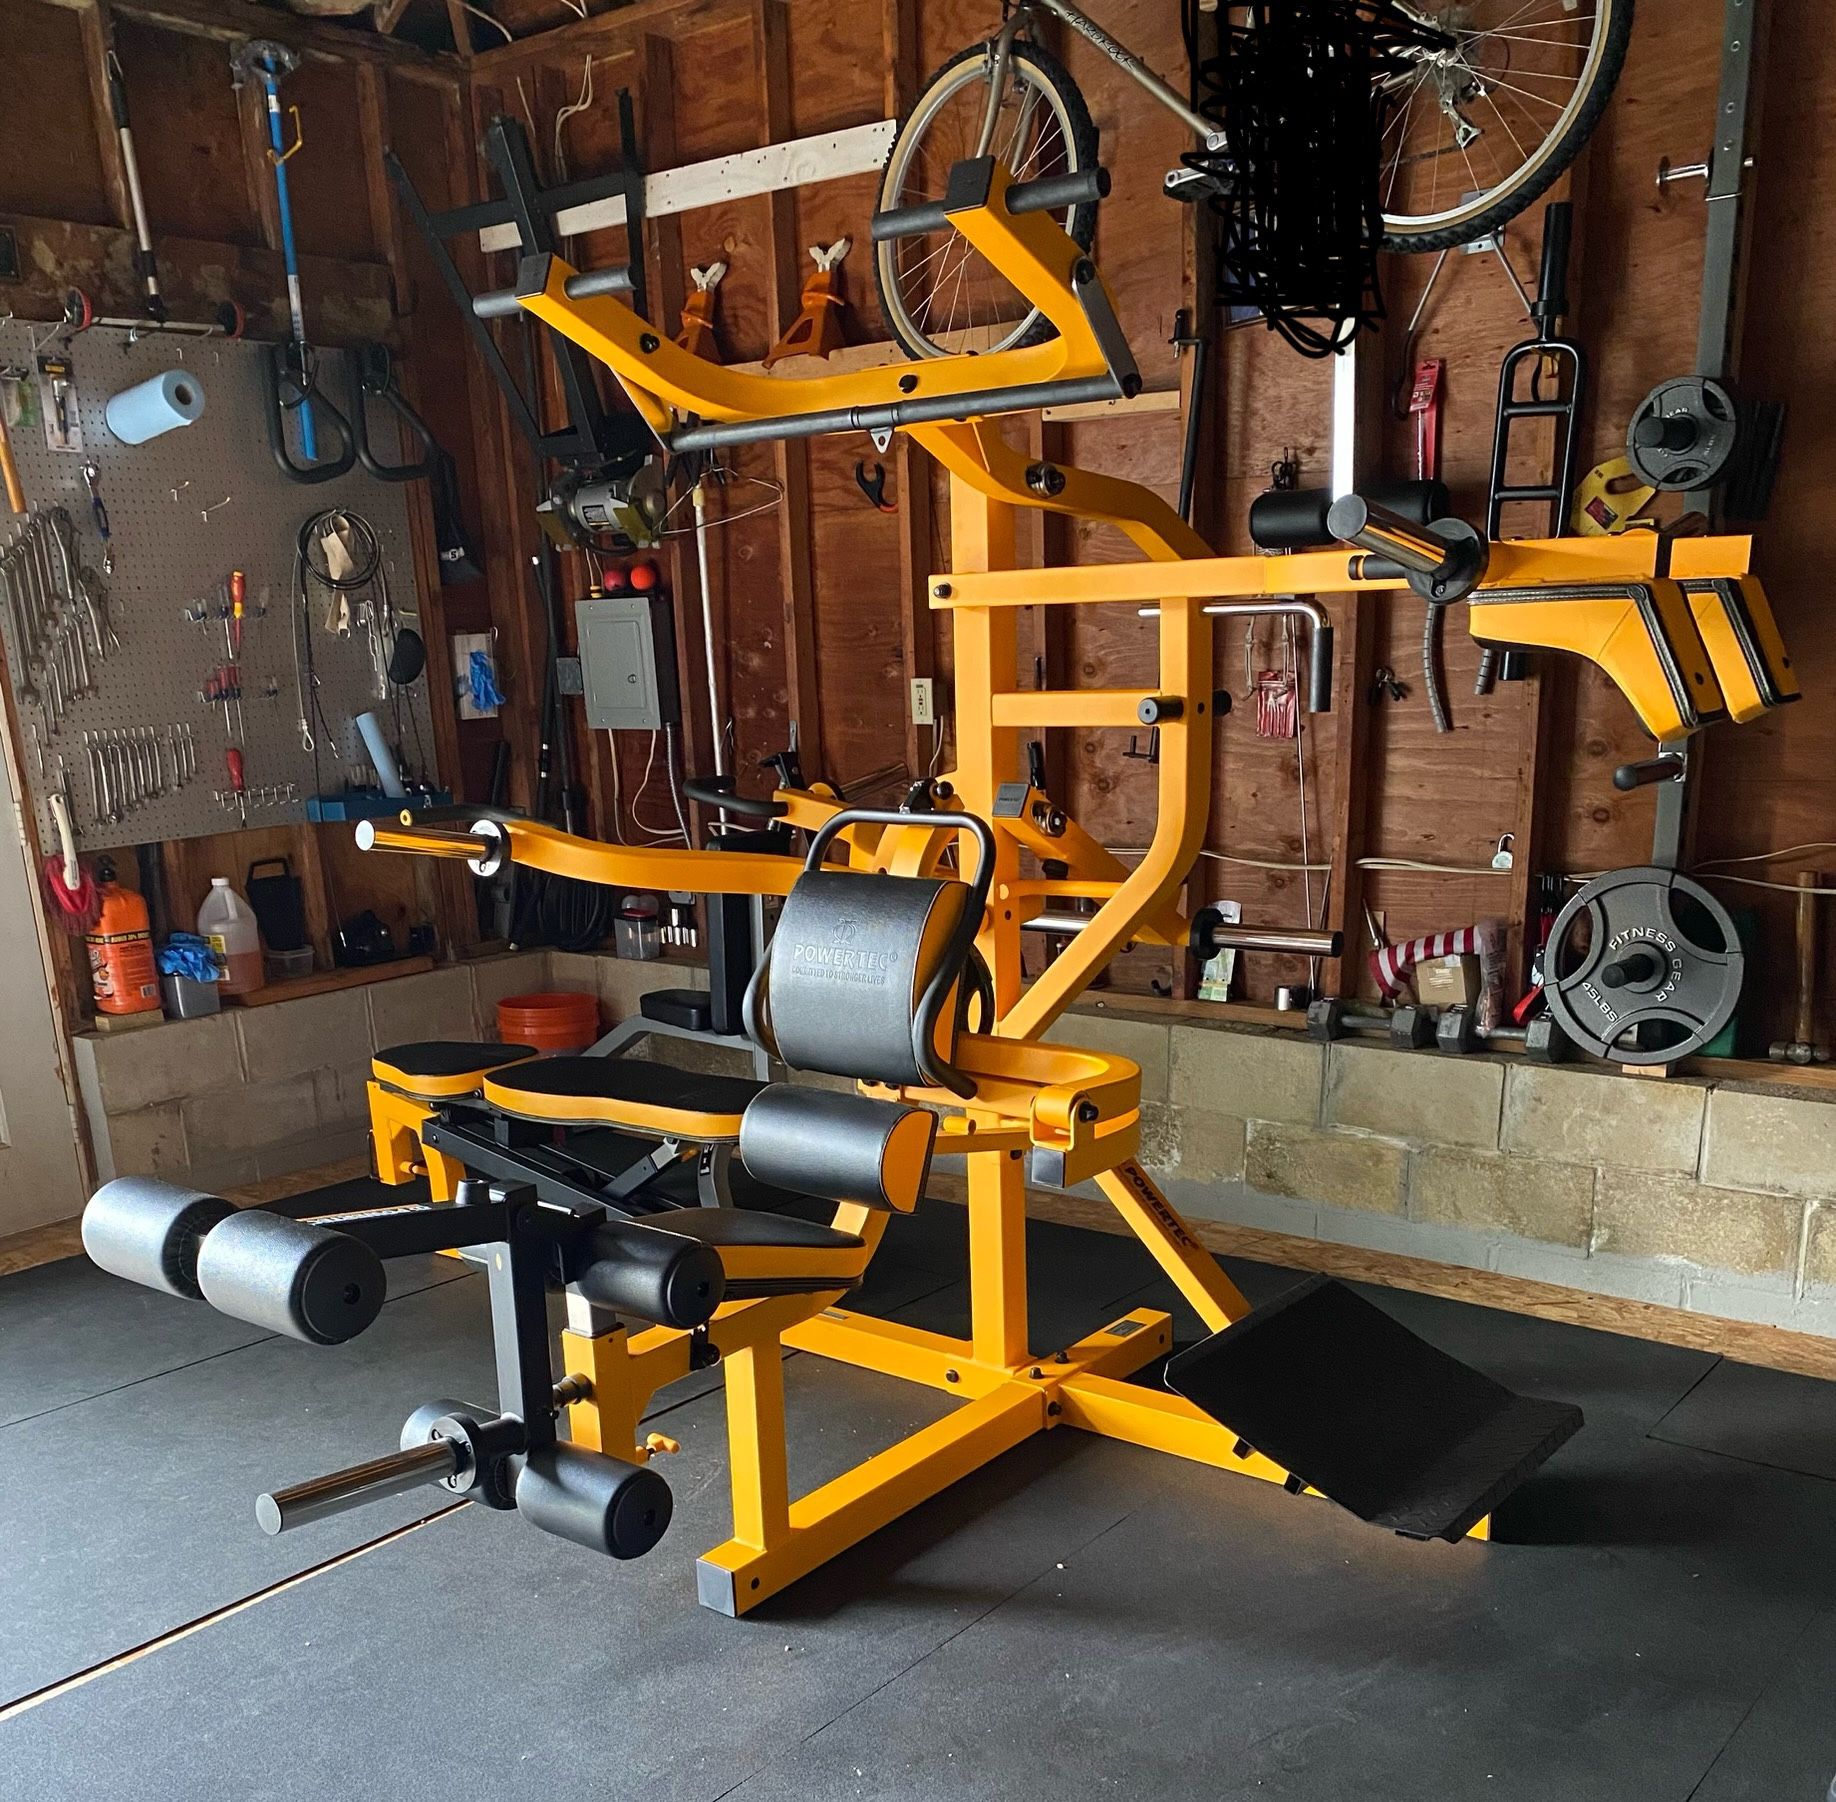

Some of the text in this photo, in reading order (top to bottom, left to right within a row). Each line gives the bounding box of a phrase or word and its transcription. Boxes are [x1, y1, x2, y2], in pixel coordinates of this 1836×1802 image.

[1066, 11, 1137, 70] HARDROCK
[825, 969, 834, 979] TO
[834, 970, 867, 984] STRONGER
[867, 975, 886, 986] LIVES
[1609, 927, 1682, 1002] FITNESS GEAR
[1582, 981, 1619, 1022] 45LBS
